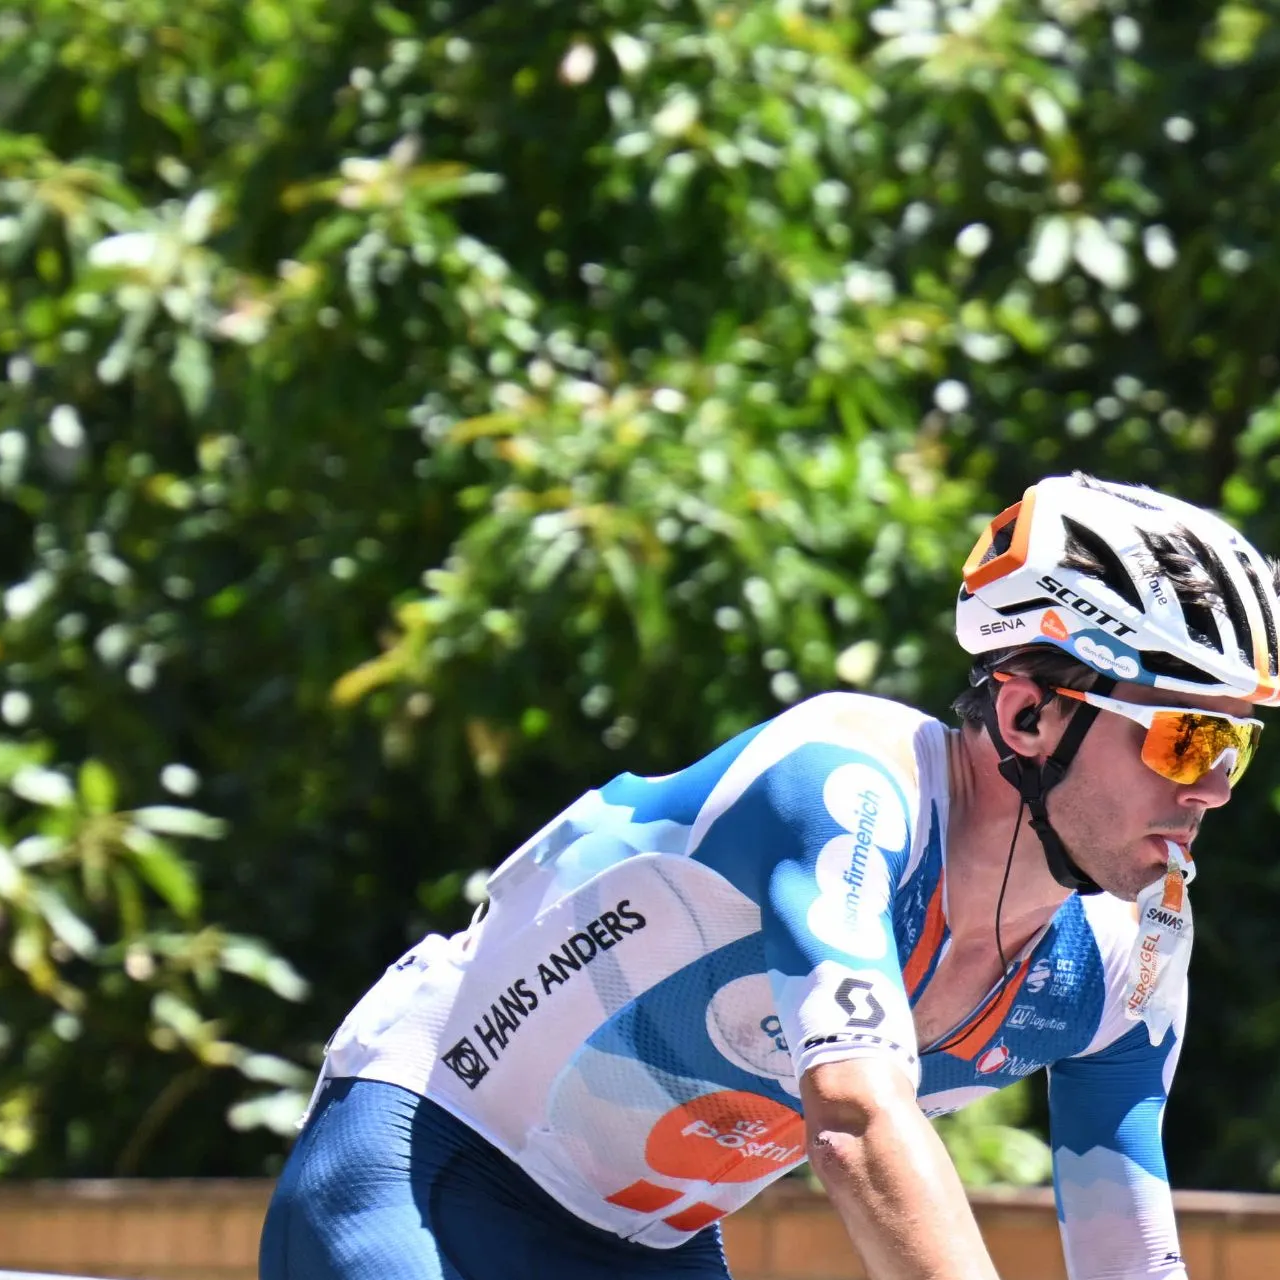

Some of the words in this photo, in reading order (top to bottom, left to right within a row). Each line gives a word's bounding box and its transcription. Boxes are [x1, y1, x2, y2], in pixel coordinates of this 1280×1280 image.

[1036, 575, 1137, 637] SCOTT
[979, 617, 1026, 636] SENA
[1081, 645, 1131, 673] dsm-firmenich
[1146, 907, 1184, 931] SANAS
[1140, 933, 1161, 963] GEL
[474, 978, 538, 1060] HANS
[537, 899, 646, 995] ANDERS
